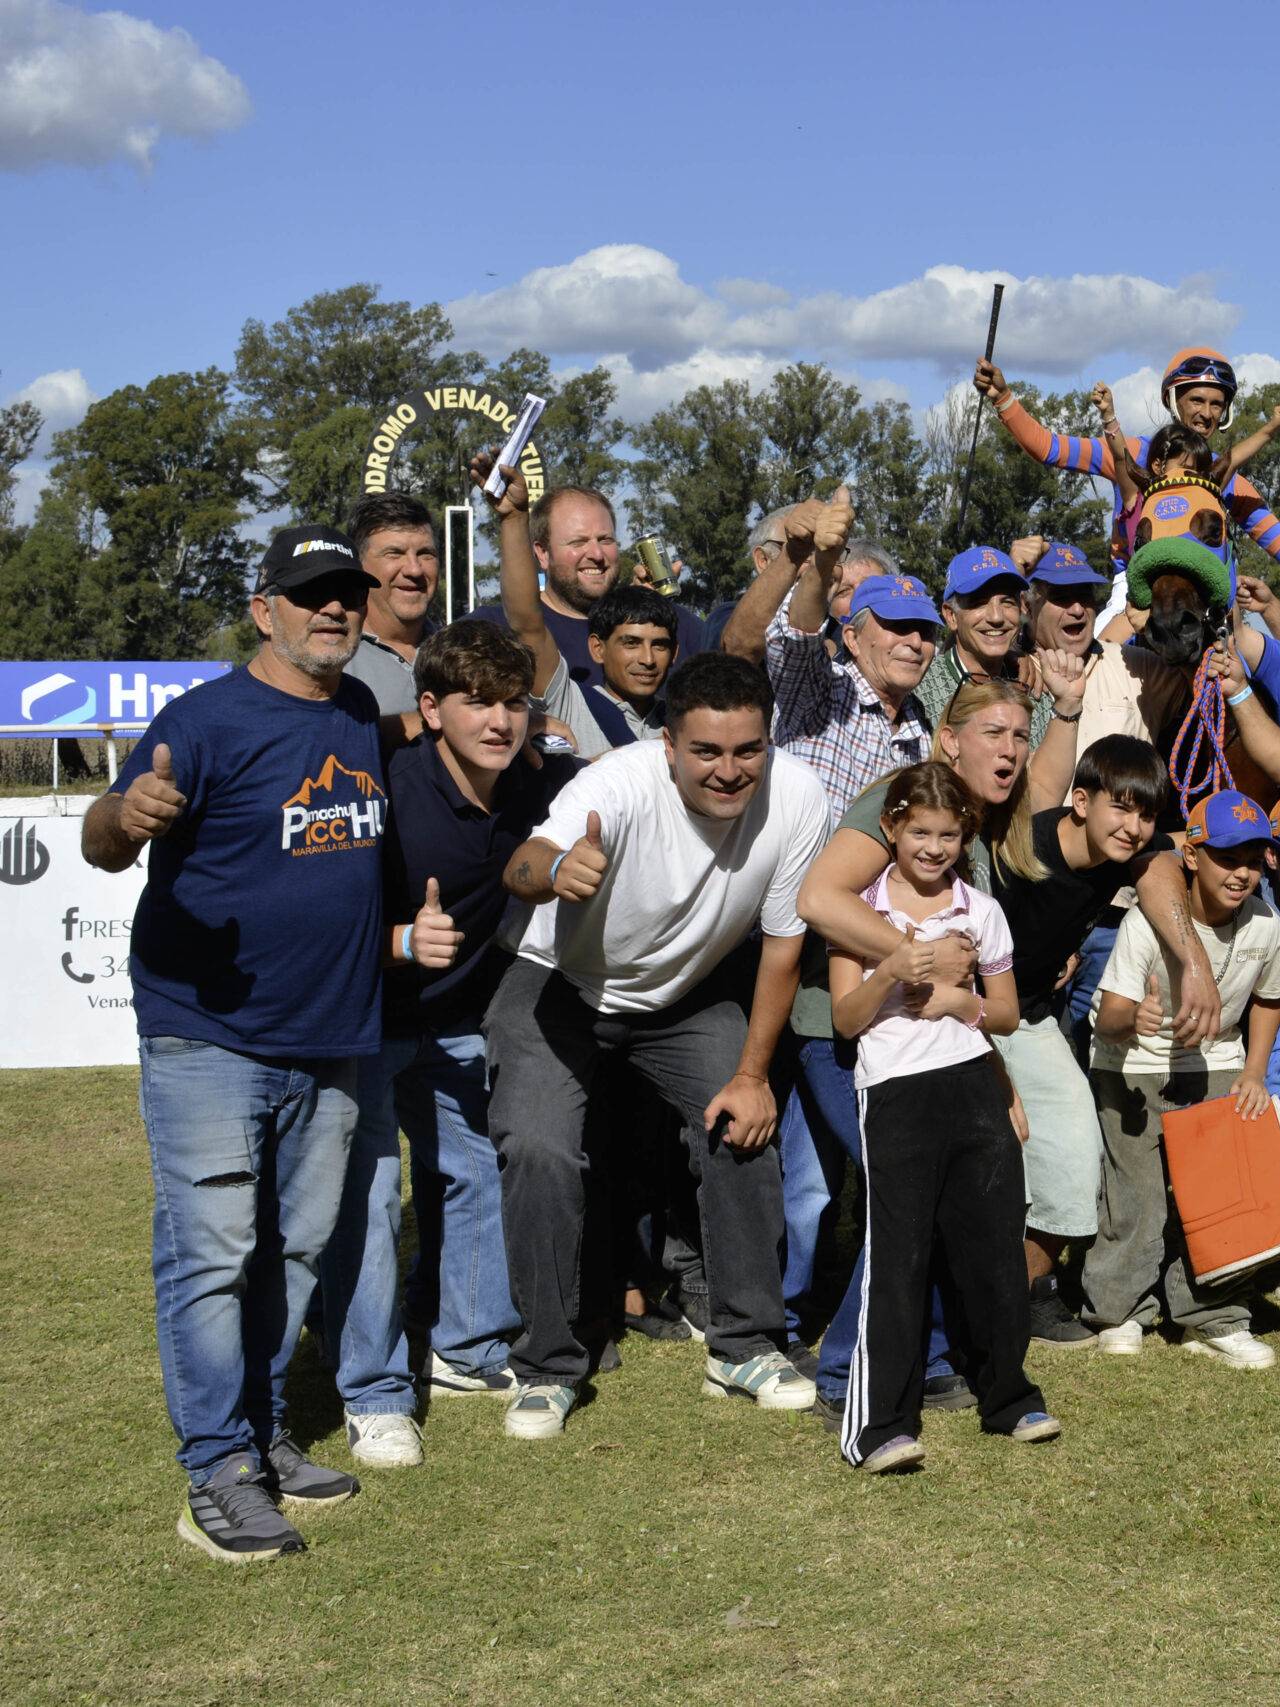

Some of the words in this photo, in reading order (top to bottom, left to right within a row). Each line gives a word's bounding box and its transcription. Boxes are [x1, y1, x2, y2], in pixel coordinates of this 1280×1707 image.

[307, 804, 351, 821] machu
[292, 845, 337, 857] MARAVILLA
[338, 842, 353, 850] DEL
[354, 839, 376, 848] MUNDO
